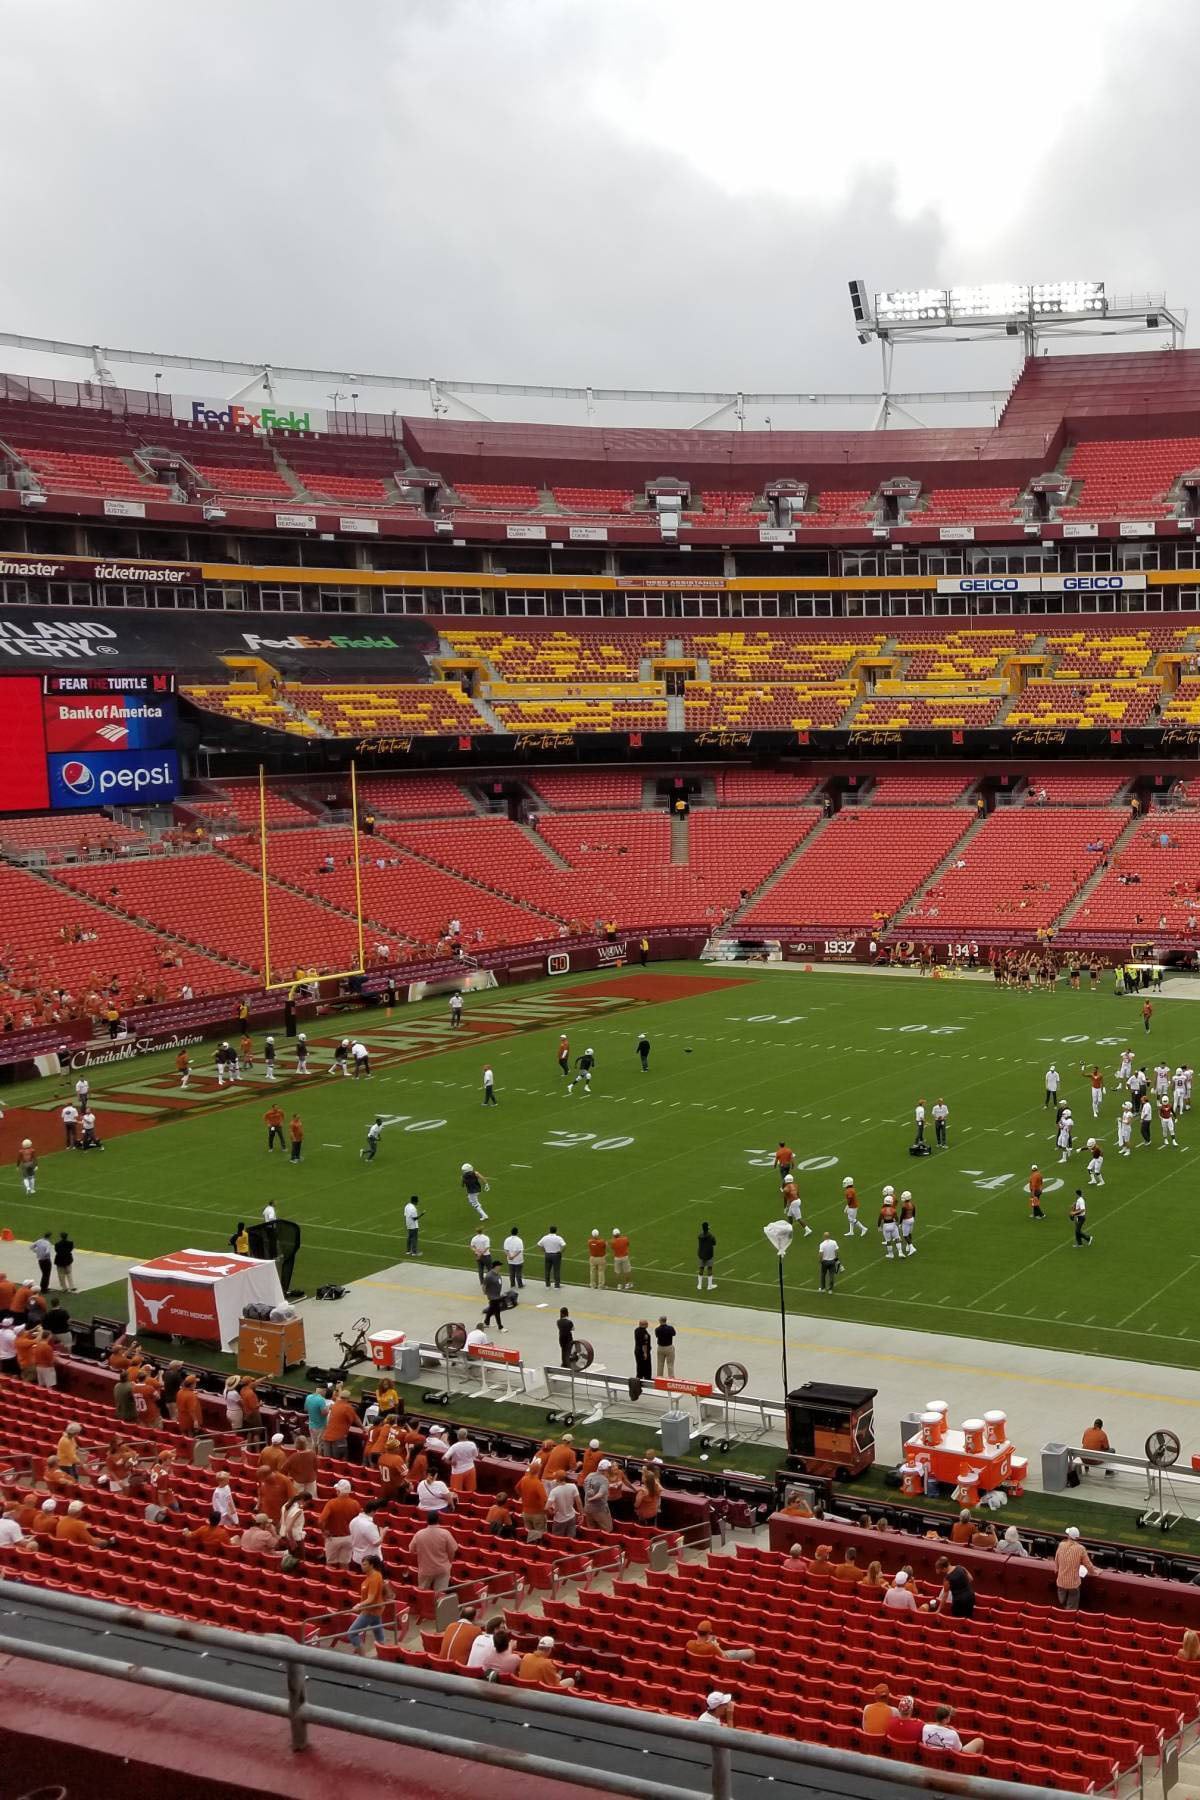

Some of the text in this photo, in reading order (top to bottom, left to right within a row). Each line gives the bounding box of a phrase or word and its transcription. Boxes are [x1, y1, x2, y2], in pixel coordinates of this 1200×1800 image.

[192, 401, 310, 431] FedExField
[94, 564, 185, 582] ticketmaster
[959, 579, 1019, 591] GEICO
[1063, 577, 1123, 589] GEICO
[242, 634, 400, 651] FedExField
[59, 704, 162, 720] Bank of America
[100, 763, 170, 793] pepsi
[824, 941, 856, 954] 1937
[71, 1034, 203, 1070] Charitable Foundation
[373, 1345, 384, 1360] G
[478, 1348, 505, 1359] GATORADE
[667, 1382, 698, 1392] GATORADE
